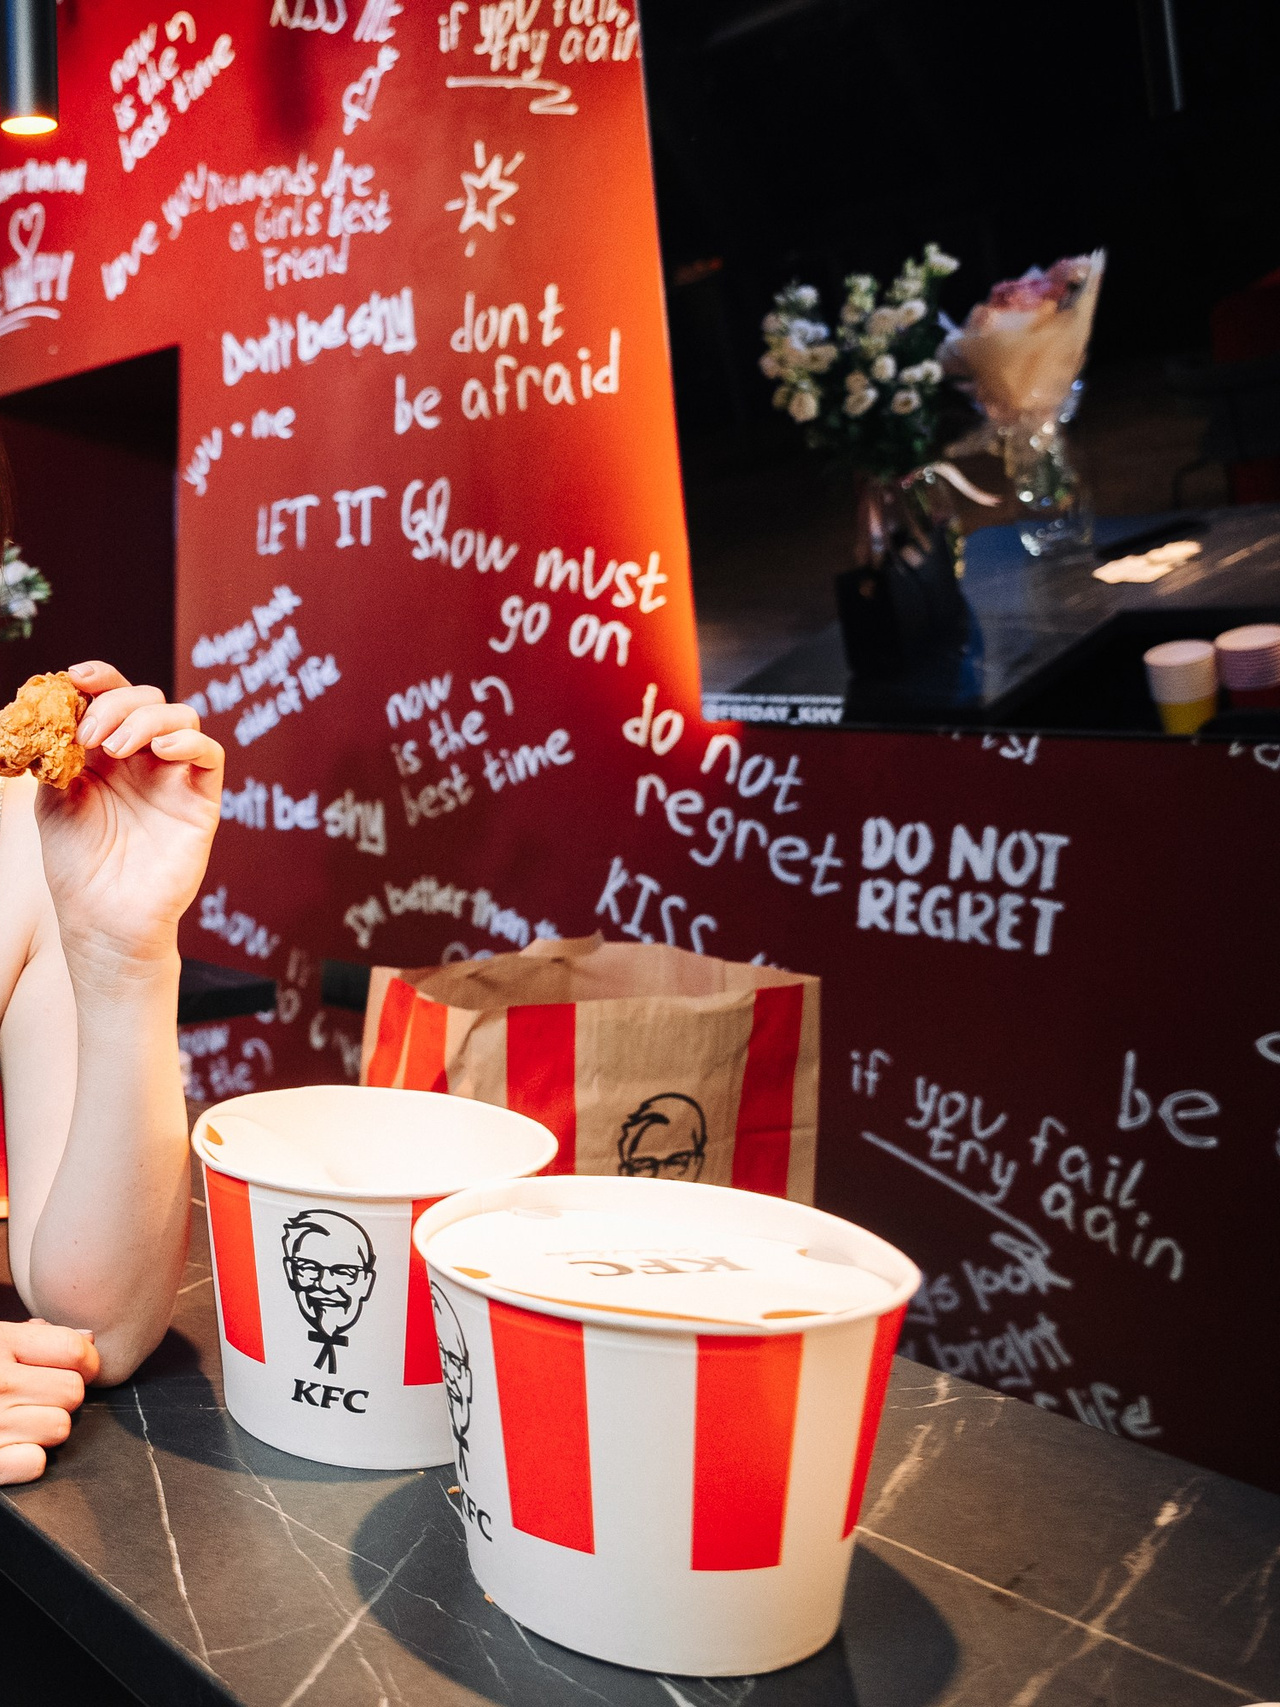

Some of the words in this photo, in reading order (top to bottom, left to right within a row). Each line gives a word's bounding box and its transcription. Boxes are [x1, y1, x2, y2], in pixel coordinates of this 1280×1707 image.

[394, 373, 442, 434] be
[461, 327, 620, 419] afraid
[256, 494, 319, 555] LET
[333, 485, 387, 547] IT
[534, 546, 668, 613] must
[489, 594, 550, 653] go
[568, 614, 632, 667] on
[386, 673, 452, 729] now
[428, 711, 489, 762] the
[400, 763, 473, 826] best
[483, 729, 574, 792] time
[621, 682, 684, 756] do
[700, 734, 804, 814] not
[635, 773, 844, 896] regret
[860, 815, 934, 875] DO
[948, 823, 1072, 892] NOT
[856, 877, 1066, 956] REGRET
[850, 1049, 892, 1097] if
[905, 1076, 1008, 1139] you
[1029, 1115, 1145, 1209] fail
[1117, 1050, 1220, 1149] be
[927, 1126, 1018, 1204] try
[568, 1255, 753, 1277] KFC
[291, 1379, 370, 1415] KFC
